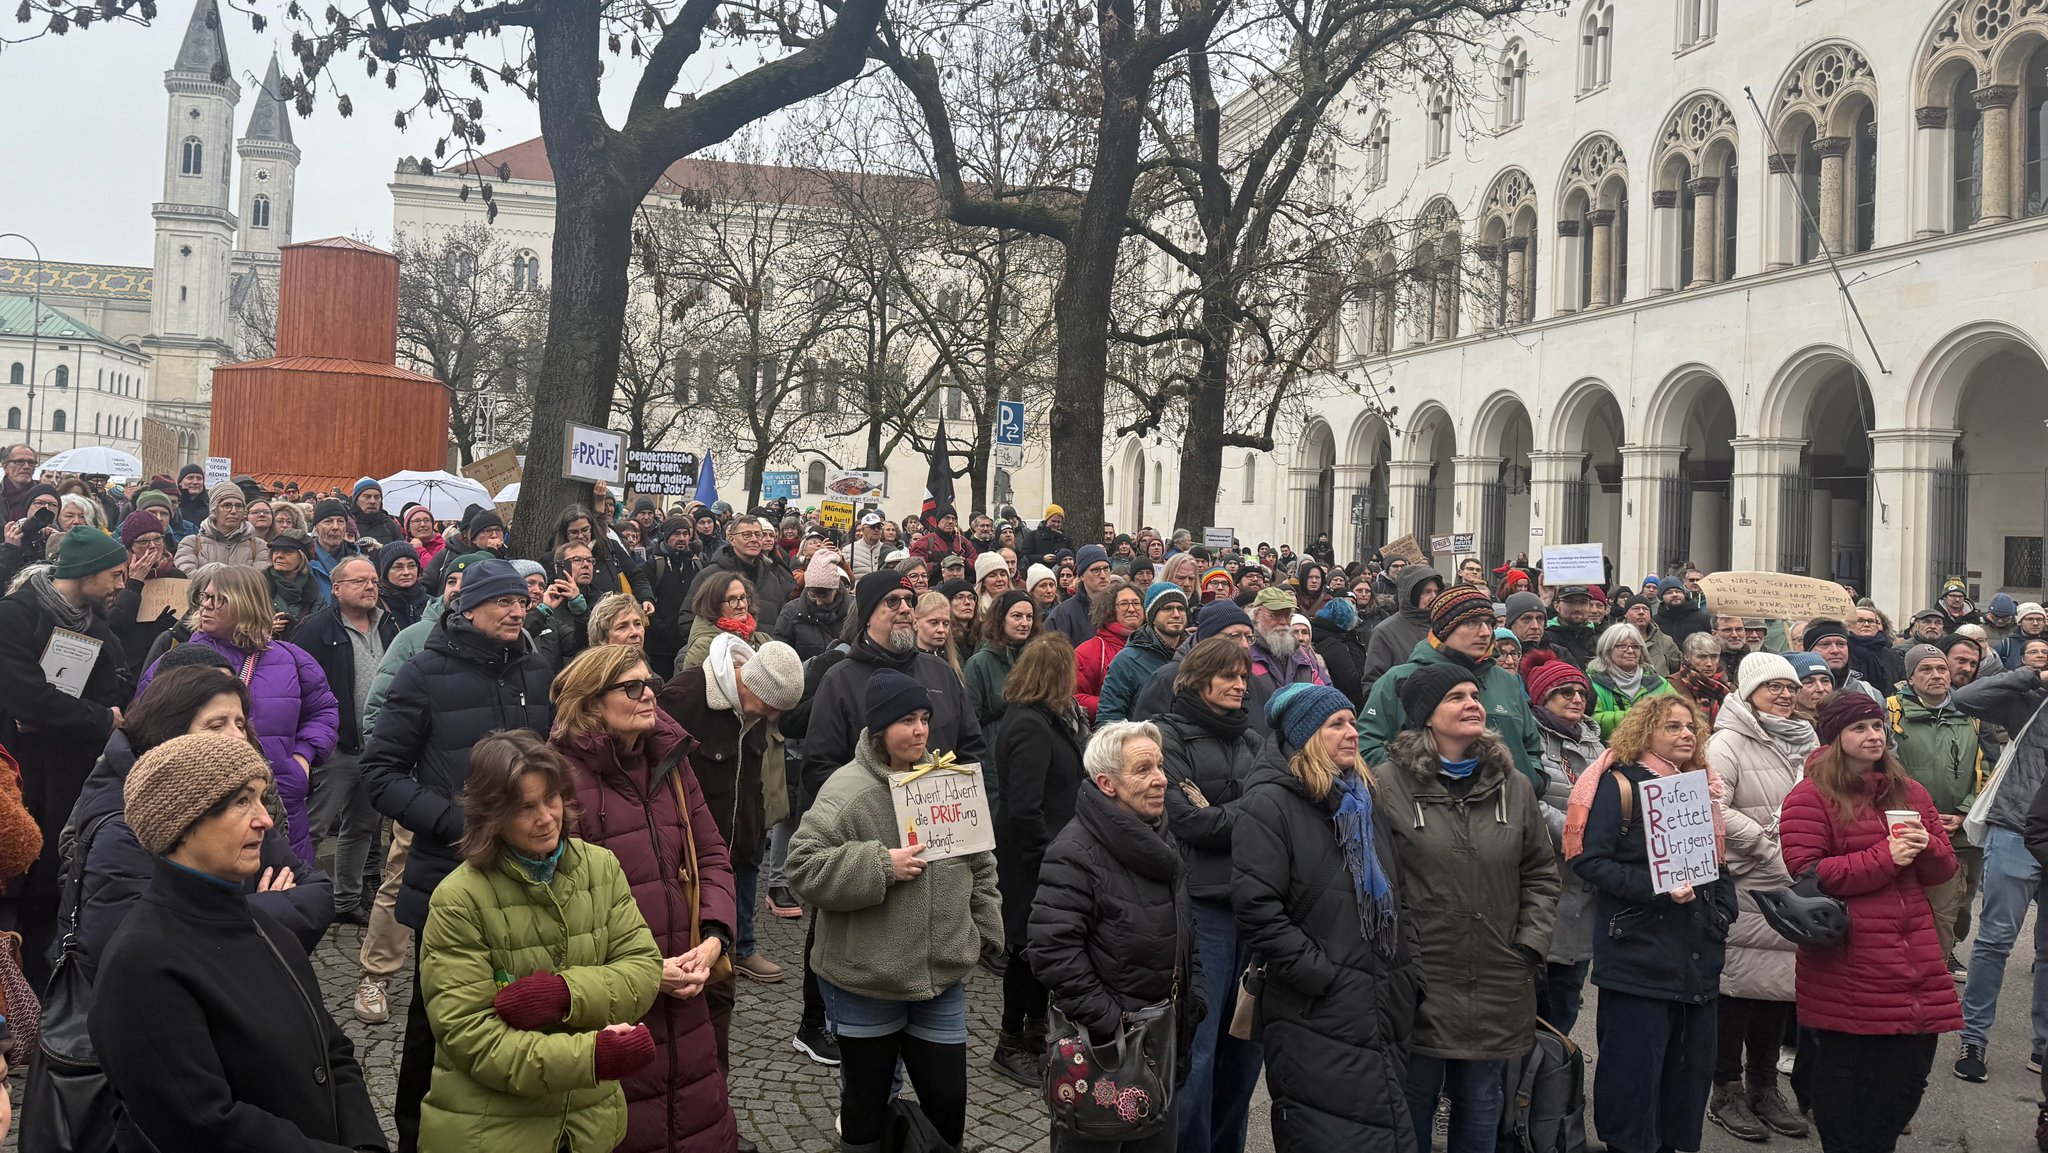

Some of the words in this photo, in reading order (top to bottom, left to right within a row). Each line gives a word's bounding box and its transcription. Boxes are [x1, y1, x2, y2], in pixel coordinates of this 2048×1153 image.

[1000, 405, 1013, 437] P
[572, 442, 619, 471] #PRÜF!
[629, 451, 693, 463] Demokratische
[640, 461, 681, 473] Parteien,
[627, 472, 657, 483] macht
[660, 473, 692, 484] endlich
[635, 483, 661, 493] euren
[663, 484, 685, 494] Job!
[825, 505, 852, 514] München
[905, 781, 945, 806] Advent,
[945, 775, 978, 801] Advent
[1644, 782, 1698, 810] Prüfen
[915, 808, 928, 826] die
[930, 803, 978, 826] PRÜFung
[1648, 805, 1711, 835] Rettet
[1651, 833, 1714, 858] Übrigens
[1652, 850, 1718, 888] Freiheit!
